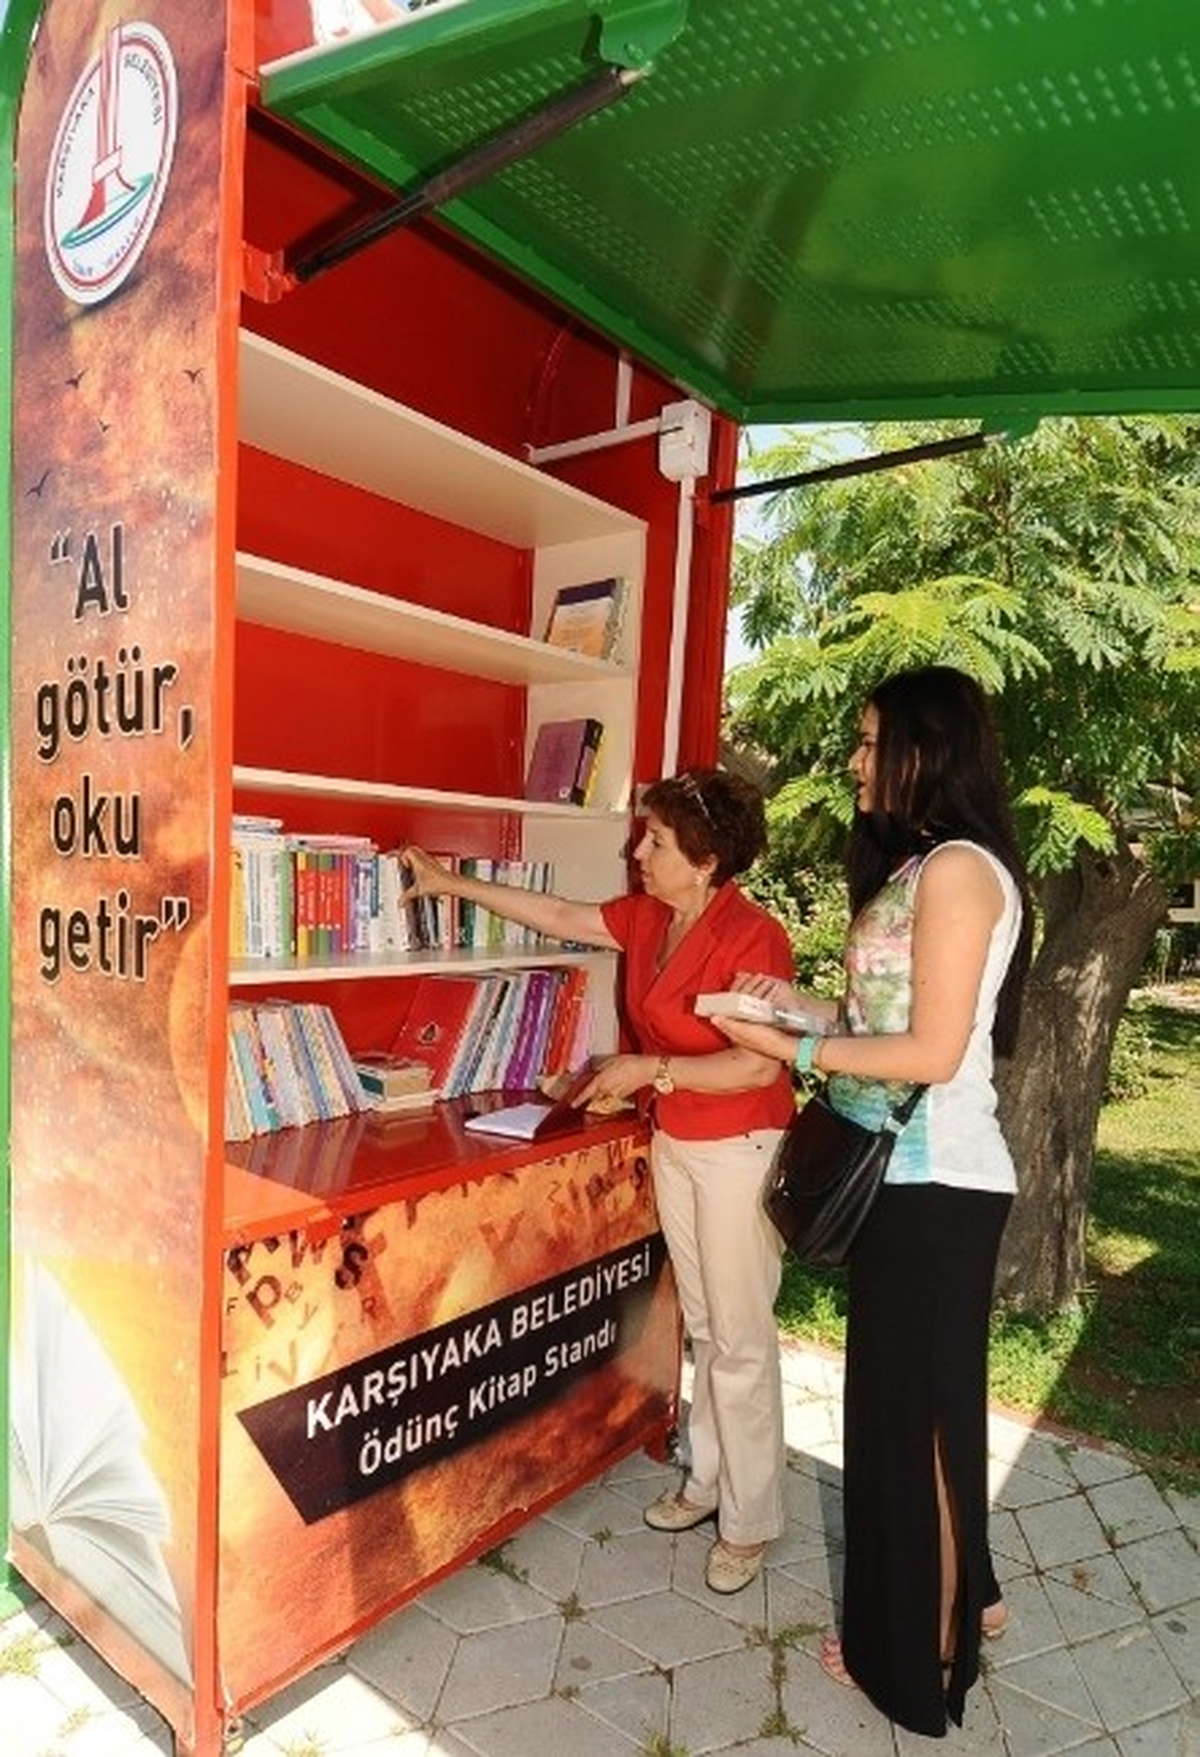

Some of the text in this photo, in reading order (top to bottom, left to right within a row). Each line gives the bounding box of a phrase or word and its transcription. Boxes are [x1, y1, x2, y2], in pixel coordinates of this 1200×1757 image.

[36, 645, 193, 760] götür,
[53, 775, 141, 857] oku
[306, 1242, 650, 1439] KARŞIYAKA BELEDİYESİ
[358, 1318, 617, 1476] Ödünç Kitap Standı
